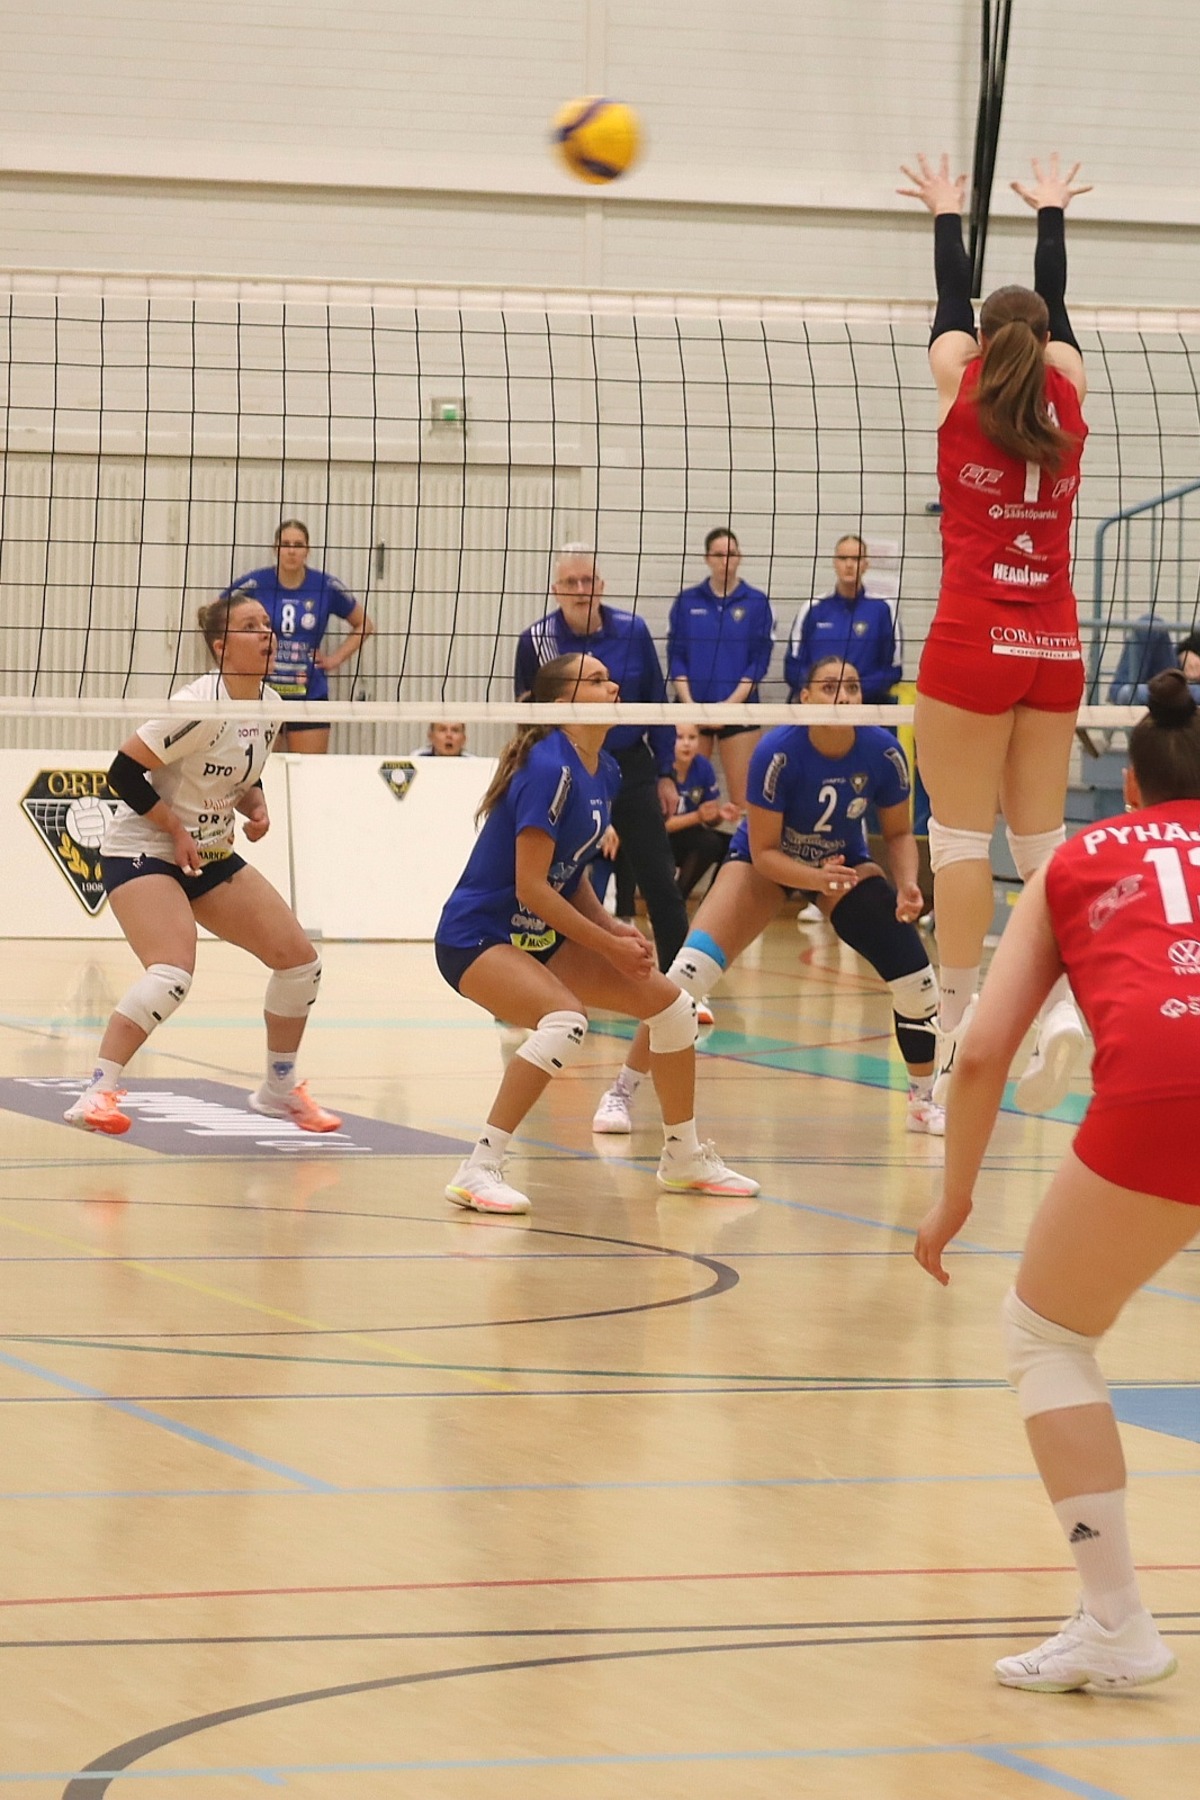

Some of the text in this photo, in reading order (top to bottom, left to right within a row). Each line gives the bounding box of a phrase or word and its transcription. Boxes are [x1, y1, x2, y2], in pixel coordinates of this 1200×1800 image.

[281, 604, 295, 637] 8
[234, 744, 253, 786] 1
[813, 785, 837, 832] 2
[81, 882, 104, 892] 1908
